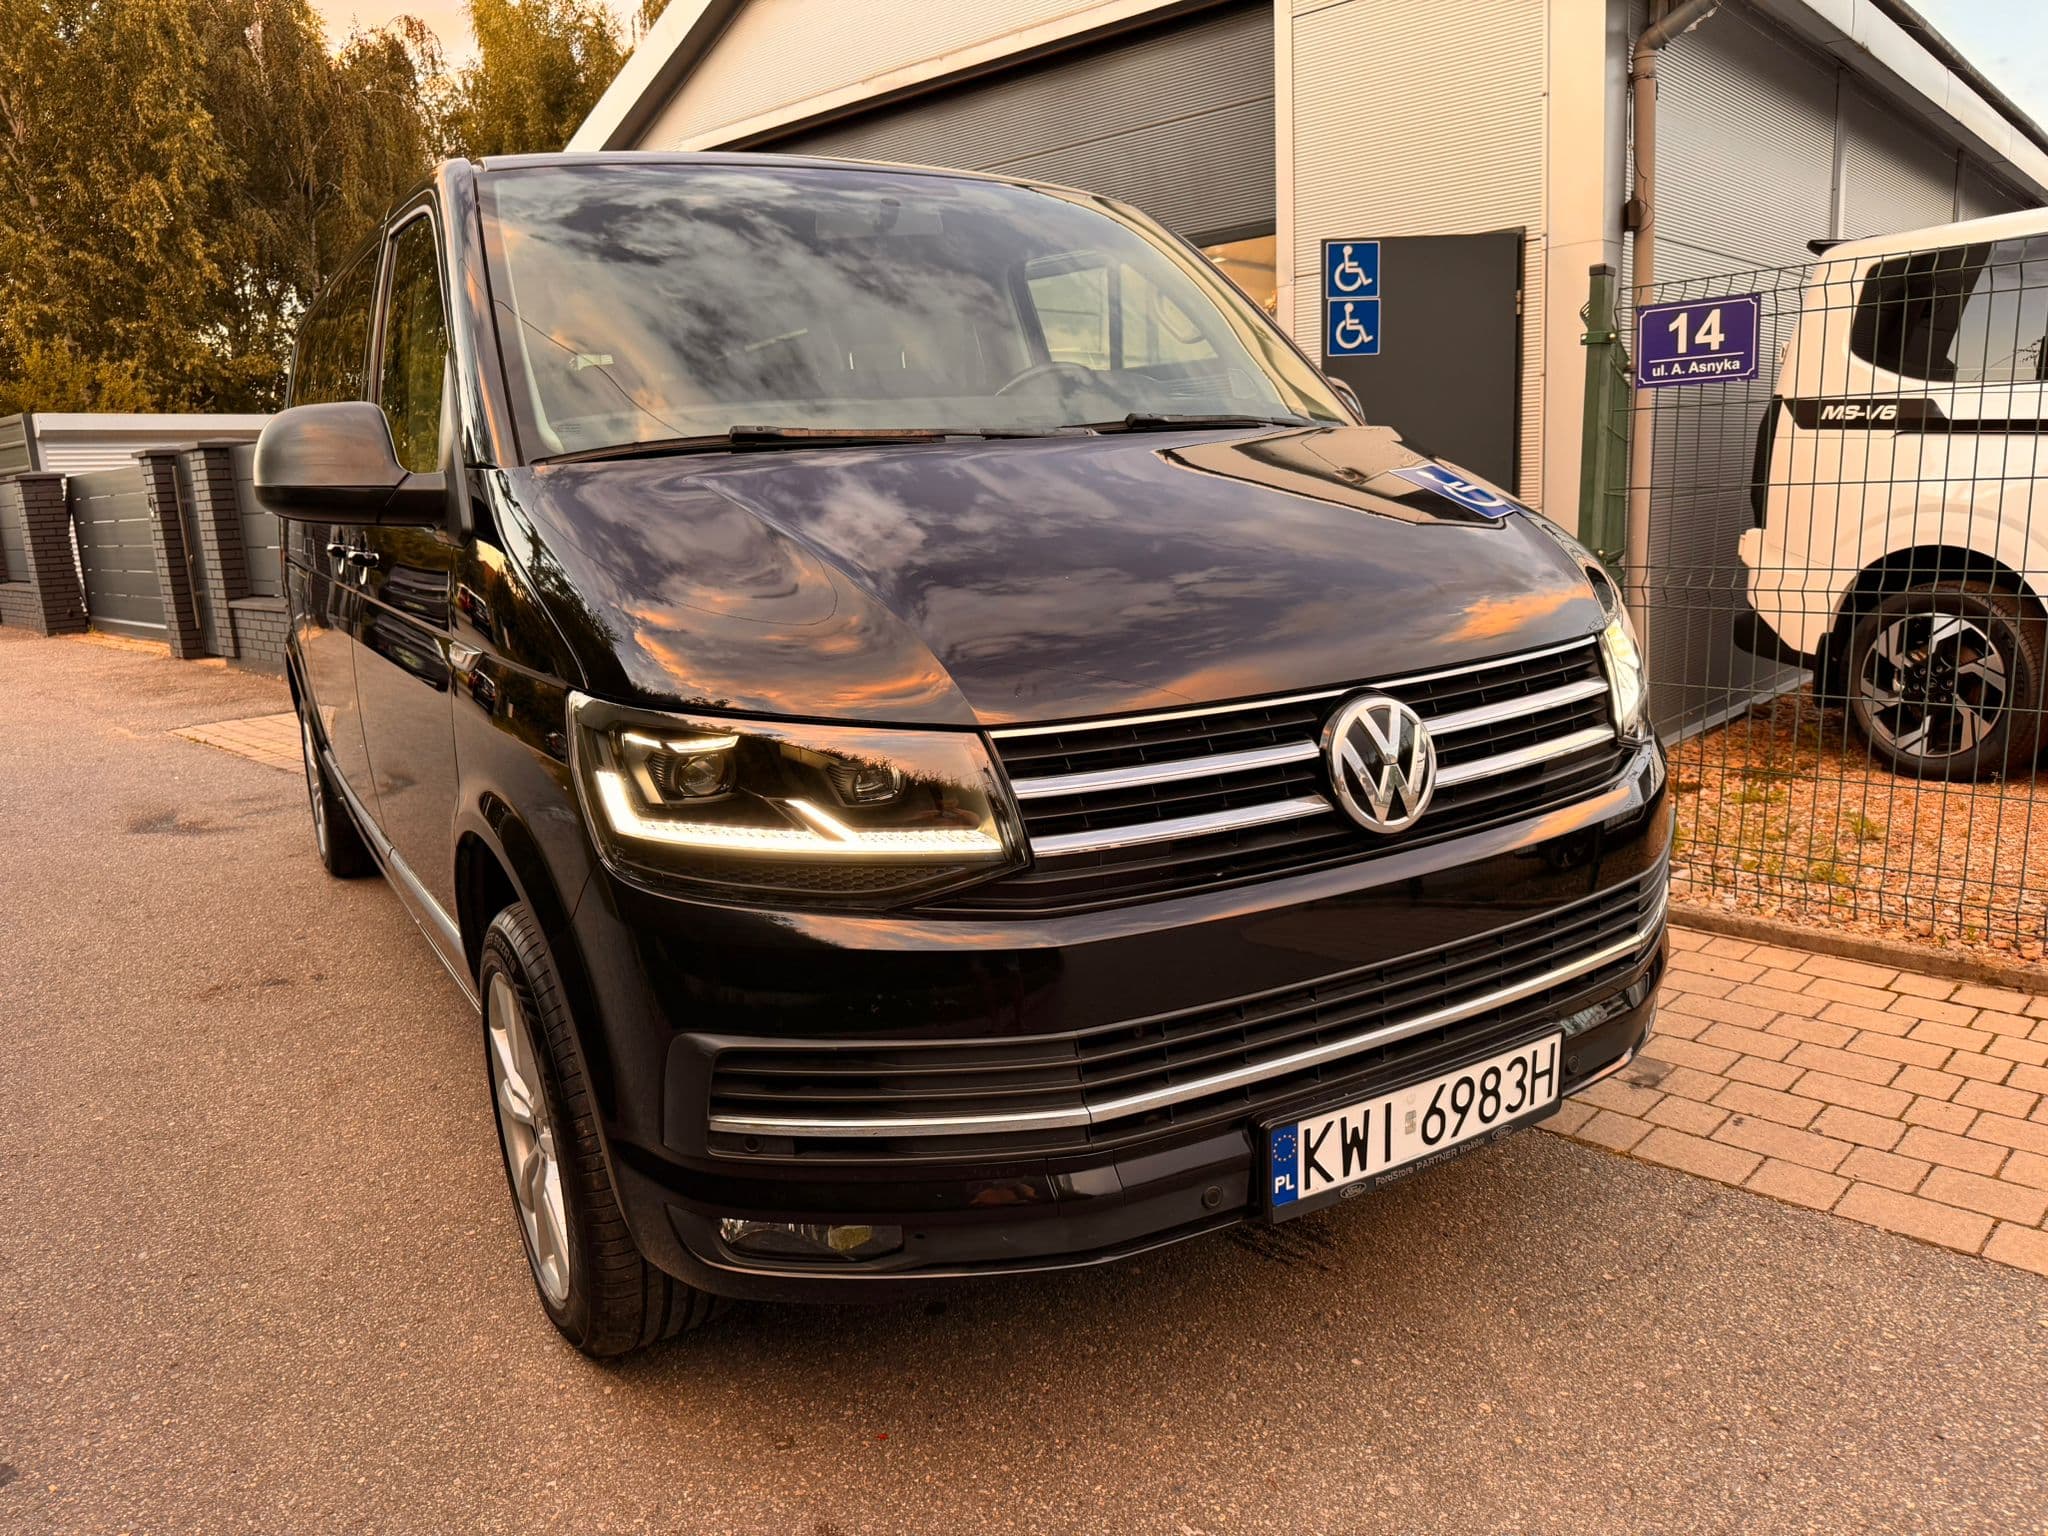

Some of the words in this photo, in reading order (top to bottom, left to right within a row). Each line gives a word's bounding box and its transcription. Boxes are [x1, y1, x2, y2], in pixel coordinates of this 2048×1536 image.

[1668, 309, 1725, 354] 14
[1652, 364, 1668, 377] ul.
[1671, 365, 1686, 375] A.
[1688, 358, 1740, 374] Asnyka
[1304, 1102, 1391, 1190] KWI
[1421, 1043, 1555, 1145] 6983H
[1416, 1149, 1457, 1170] PARTNER
[1274, 1173, 1295, 1194] PL
